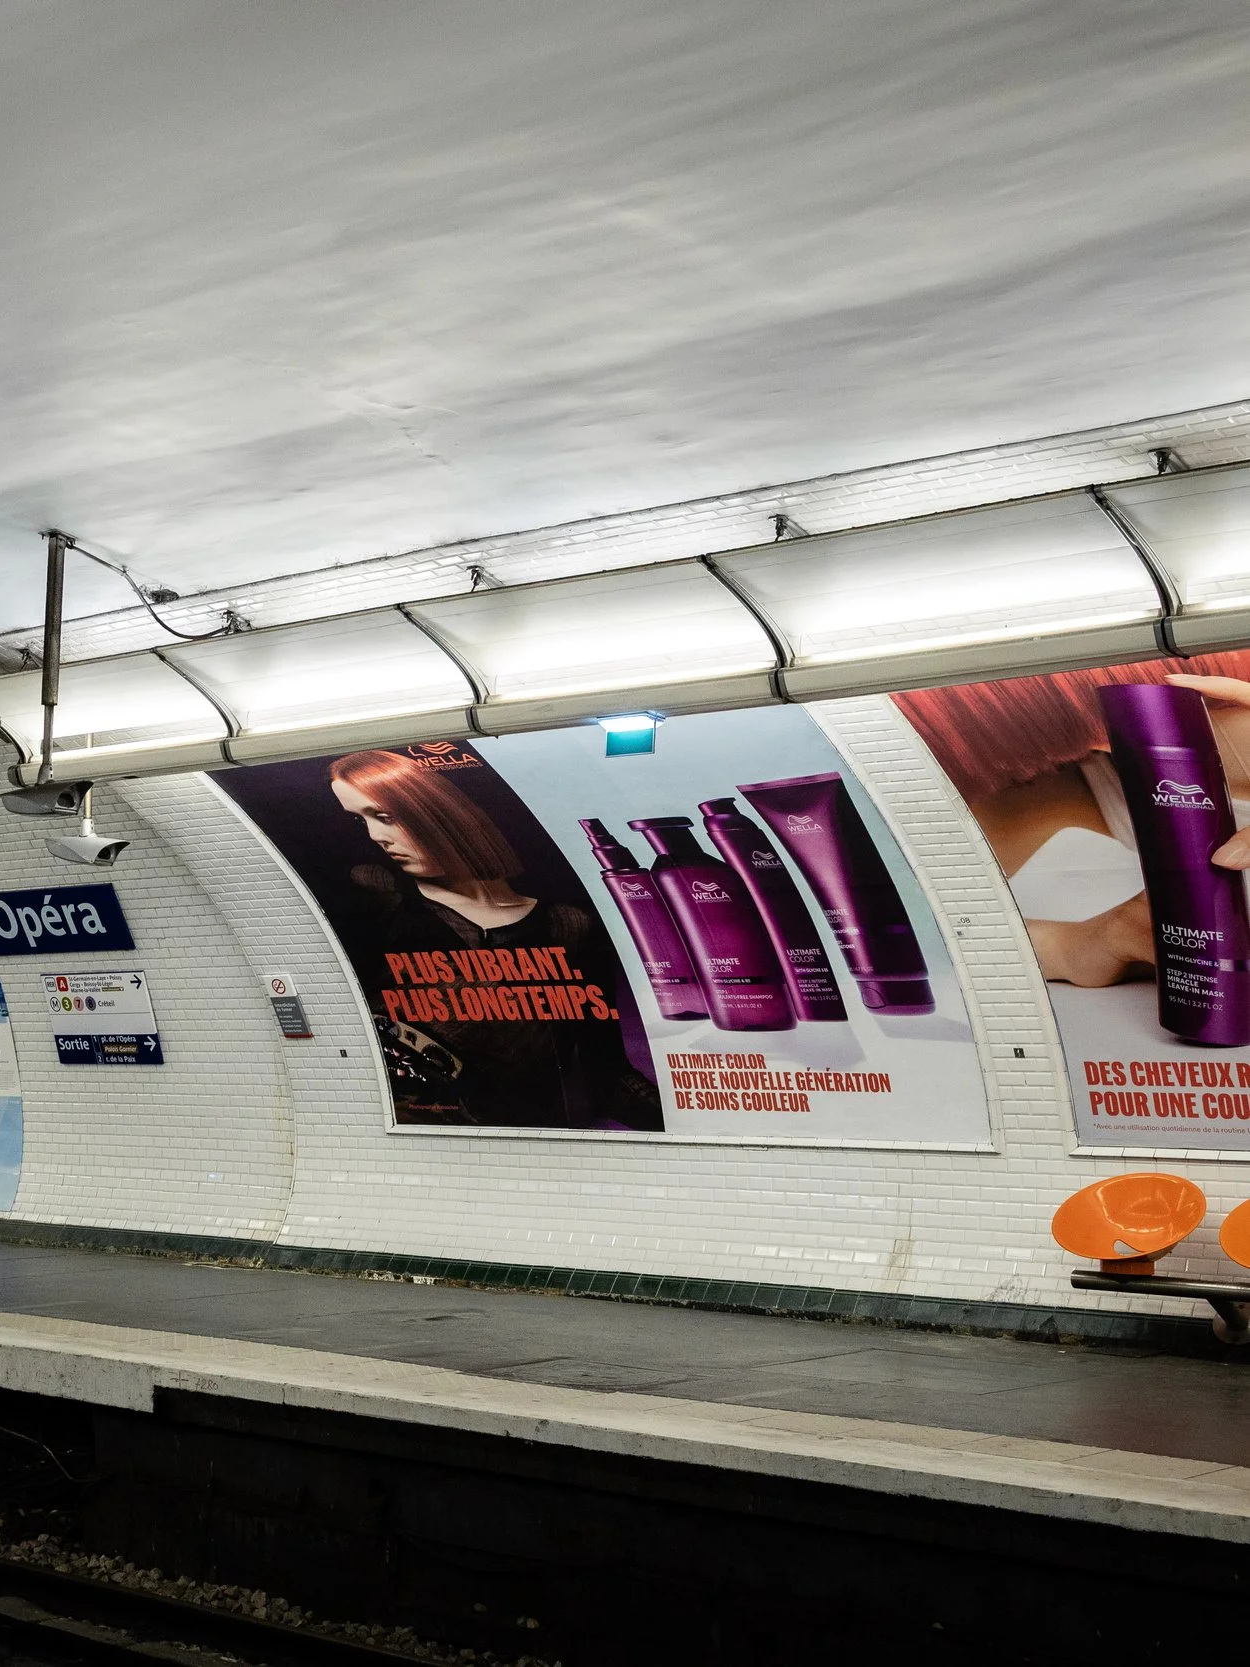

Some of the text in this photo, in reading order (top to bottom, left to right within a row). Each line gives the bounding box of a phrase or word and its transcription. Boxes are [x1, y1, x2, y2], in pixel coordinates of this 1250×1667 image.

[416, 753, 478, 767] WELLA
[1152, 794, 1214, 806] WELLA
[1155, 802, 1215, 810] PROFESSIONALS
[692, 891, 730, 900] WELLA
[1162, 924, 1224, 941] ULTIMATE
[1163, 934, 1206, 950] COLOR
[385, 947, 583, 985] PLUS VIBRANT.
[1167, 953, 1183, 961] WITH
[1185, 957, 1213, 967] GLYCINE
[1167, 968, 1182, 976] STEP
[1189, 973, 1218, 984] INTENSE
[1167, 975, 1199, 987] MIRACLE
[59, 980, 65, 989] A
[1168, 982, 1224, 998] LEAVE-IN MASK
[88, 999, 93, 1008] 8
[381, 985, 620, 1023] PLUS LONGTEMPS.
[1178, 997, 1187, 1005] ML
[58, 1038, 89, 1050] Sortie
[667, 1054, 767, 1069] ULTIMATE COLOR
[671, 1067, 891, 1093] NOTRE NOUVELLE GÉNÉRATION
[1084, 1061, 1127, 1085] DES
[1130, 1062, 1234, 1088] CHEVEUX
[675, 1091, 810, 1112] DE SOINS COULEUR
[1089, 1091, 1151, 1117] POUR
[1153, 1092, 1199, 1118] UNE
[1161, 1125, 1201, 1134] quotidienne
